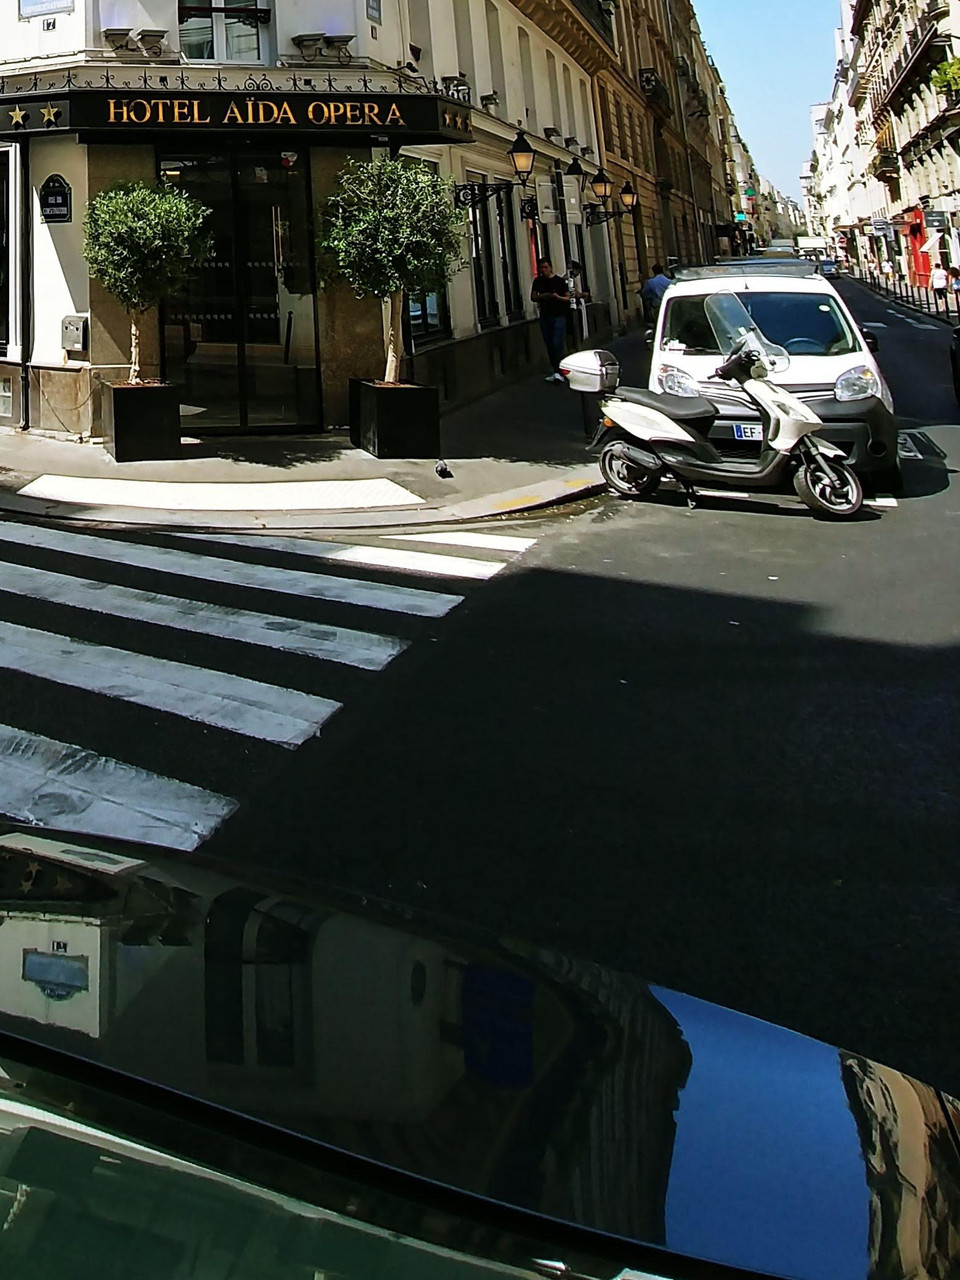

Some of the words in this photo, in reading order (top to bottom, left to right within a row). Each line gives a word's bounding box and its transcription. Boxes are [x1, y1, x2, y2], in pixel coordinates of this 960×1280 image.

[107, 99, 211, 123] HOTEL
[222, 97, 297, 124] AÏDA
[307, 101, 407, 126] OPERA
